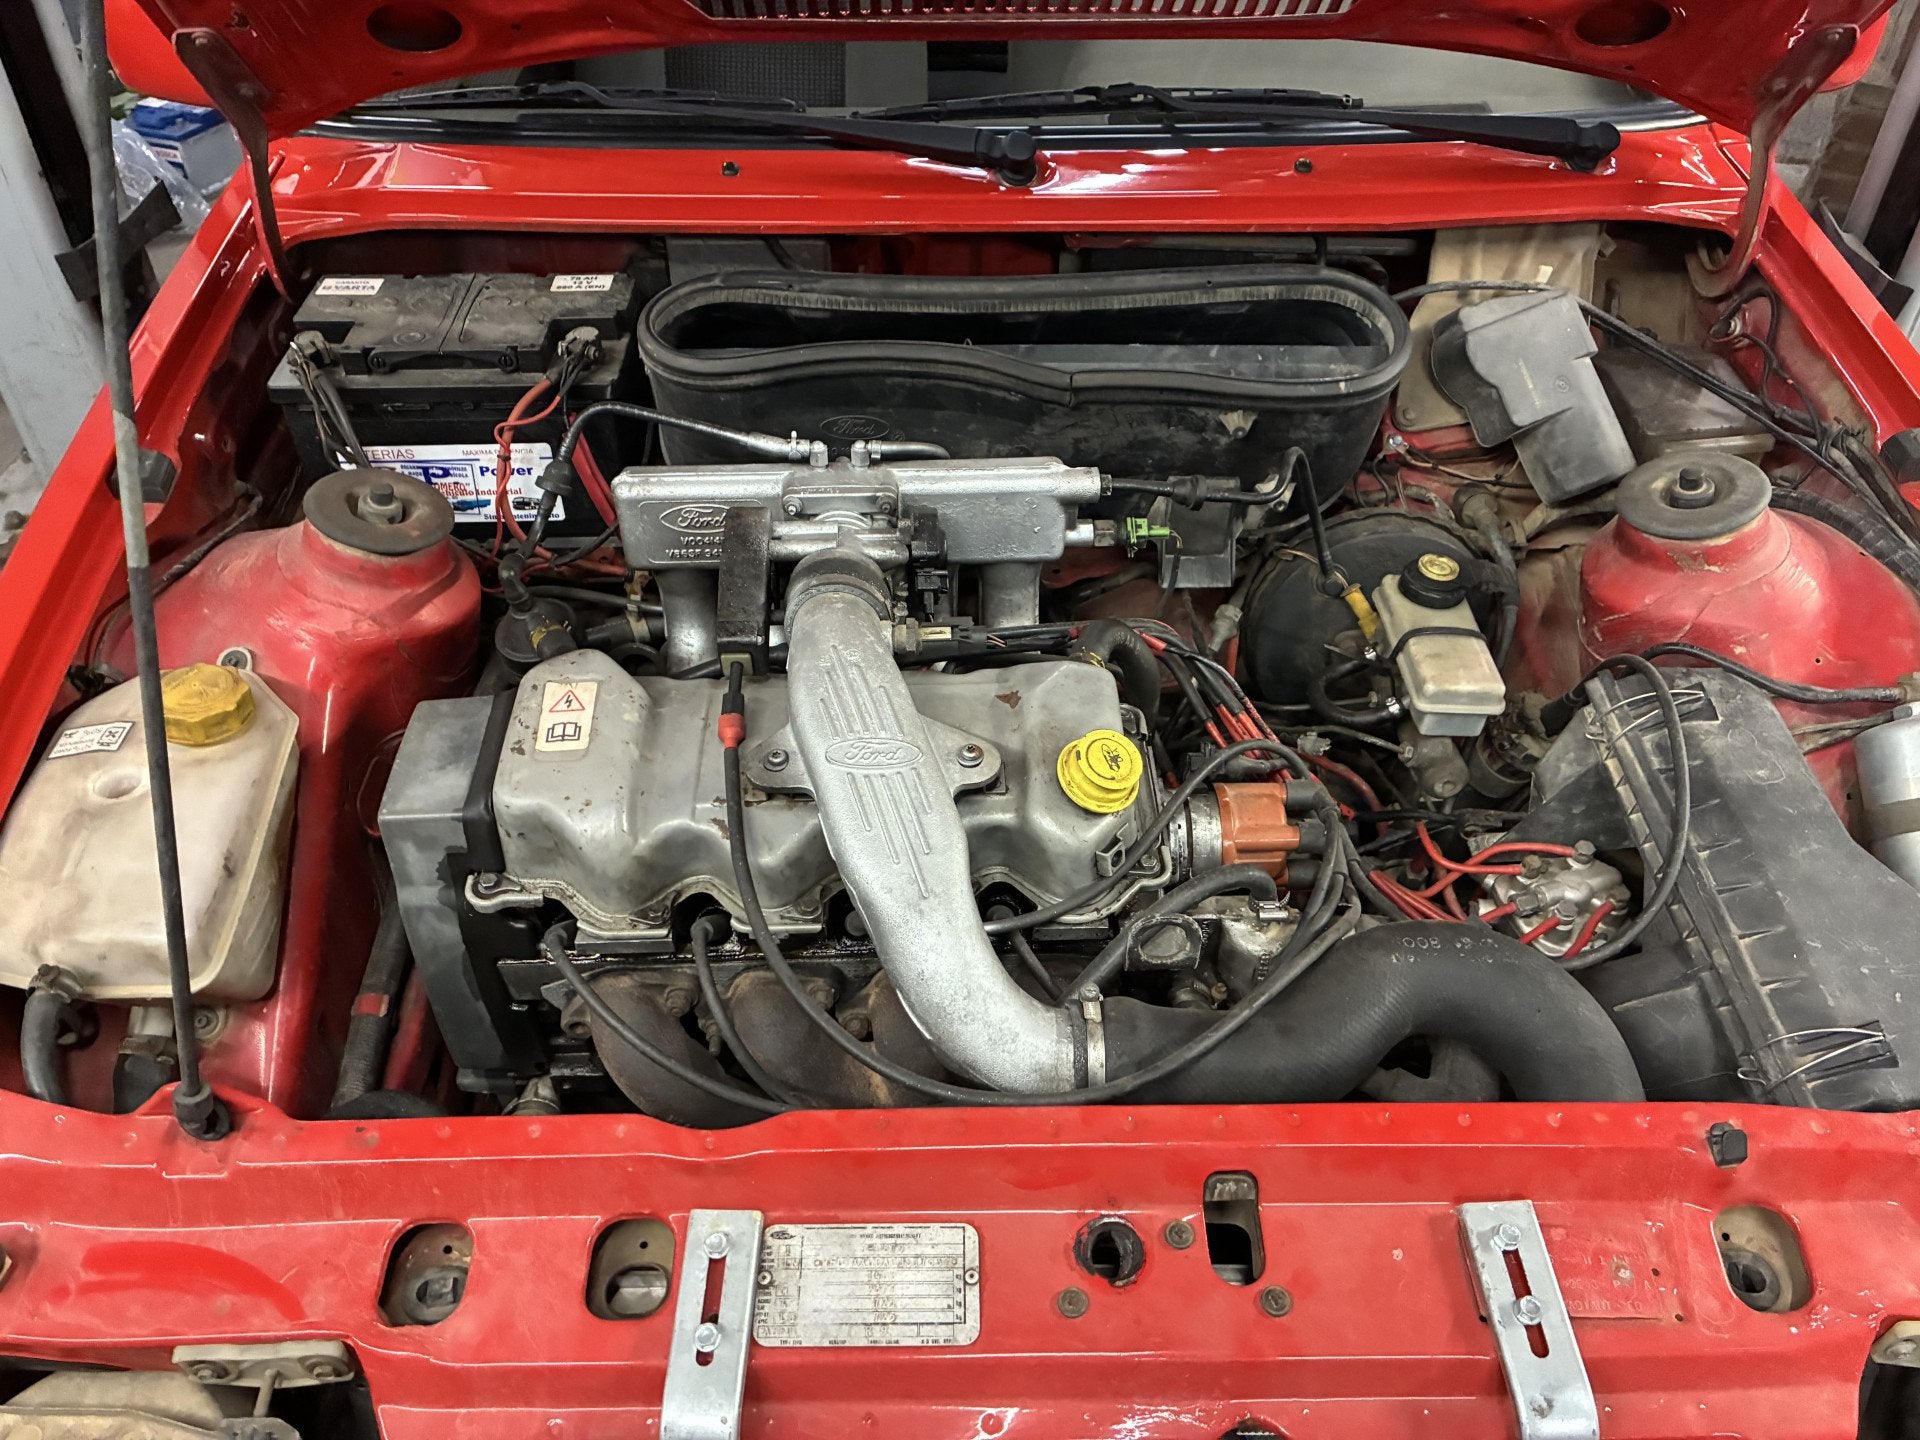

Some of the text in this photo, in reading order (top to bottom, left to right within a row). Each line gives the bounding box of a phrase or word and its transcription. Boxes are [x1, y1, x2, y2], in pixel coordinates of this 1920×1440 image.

[364, 448, 416, 461] TERIAS
[476, 488, 523, 497] Indurial
[677, 507, 727, 528] Ford
[843, 740, 902, 762] Ford
